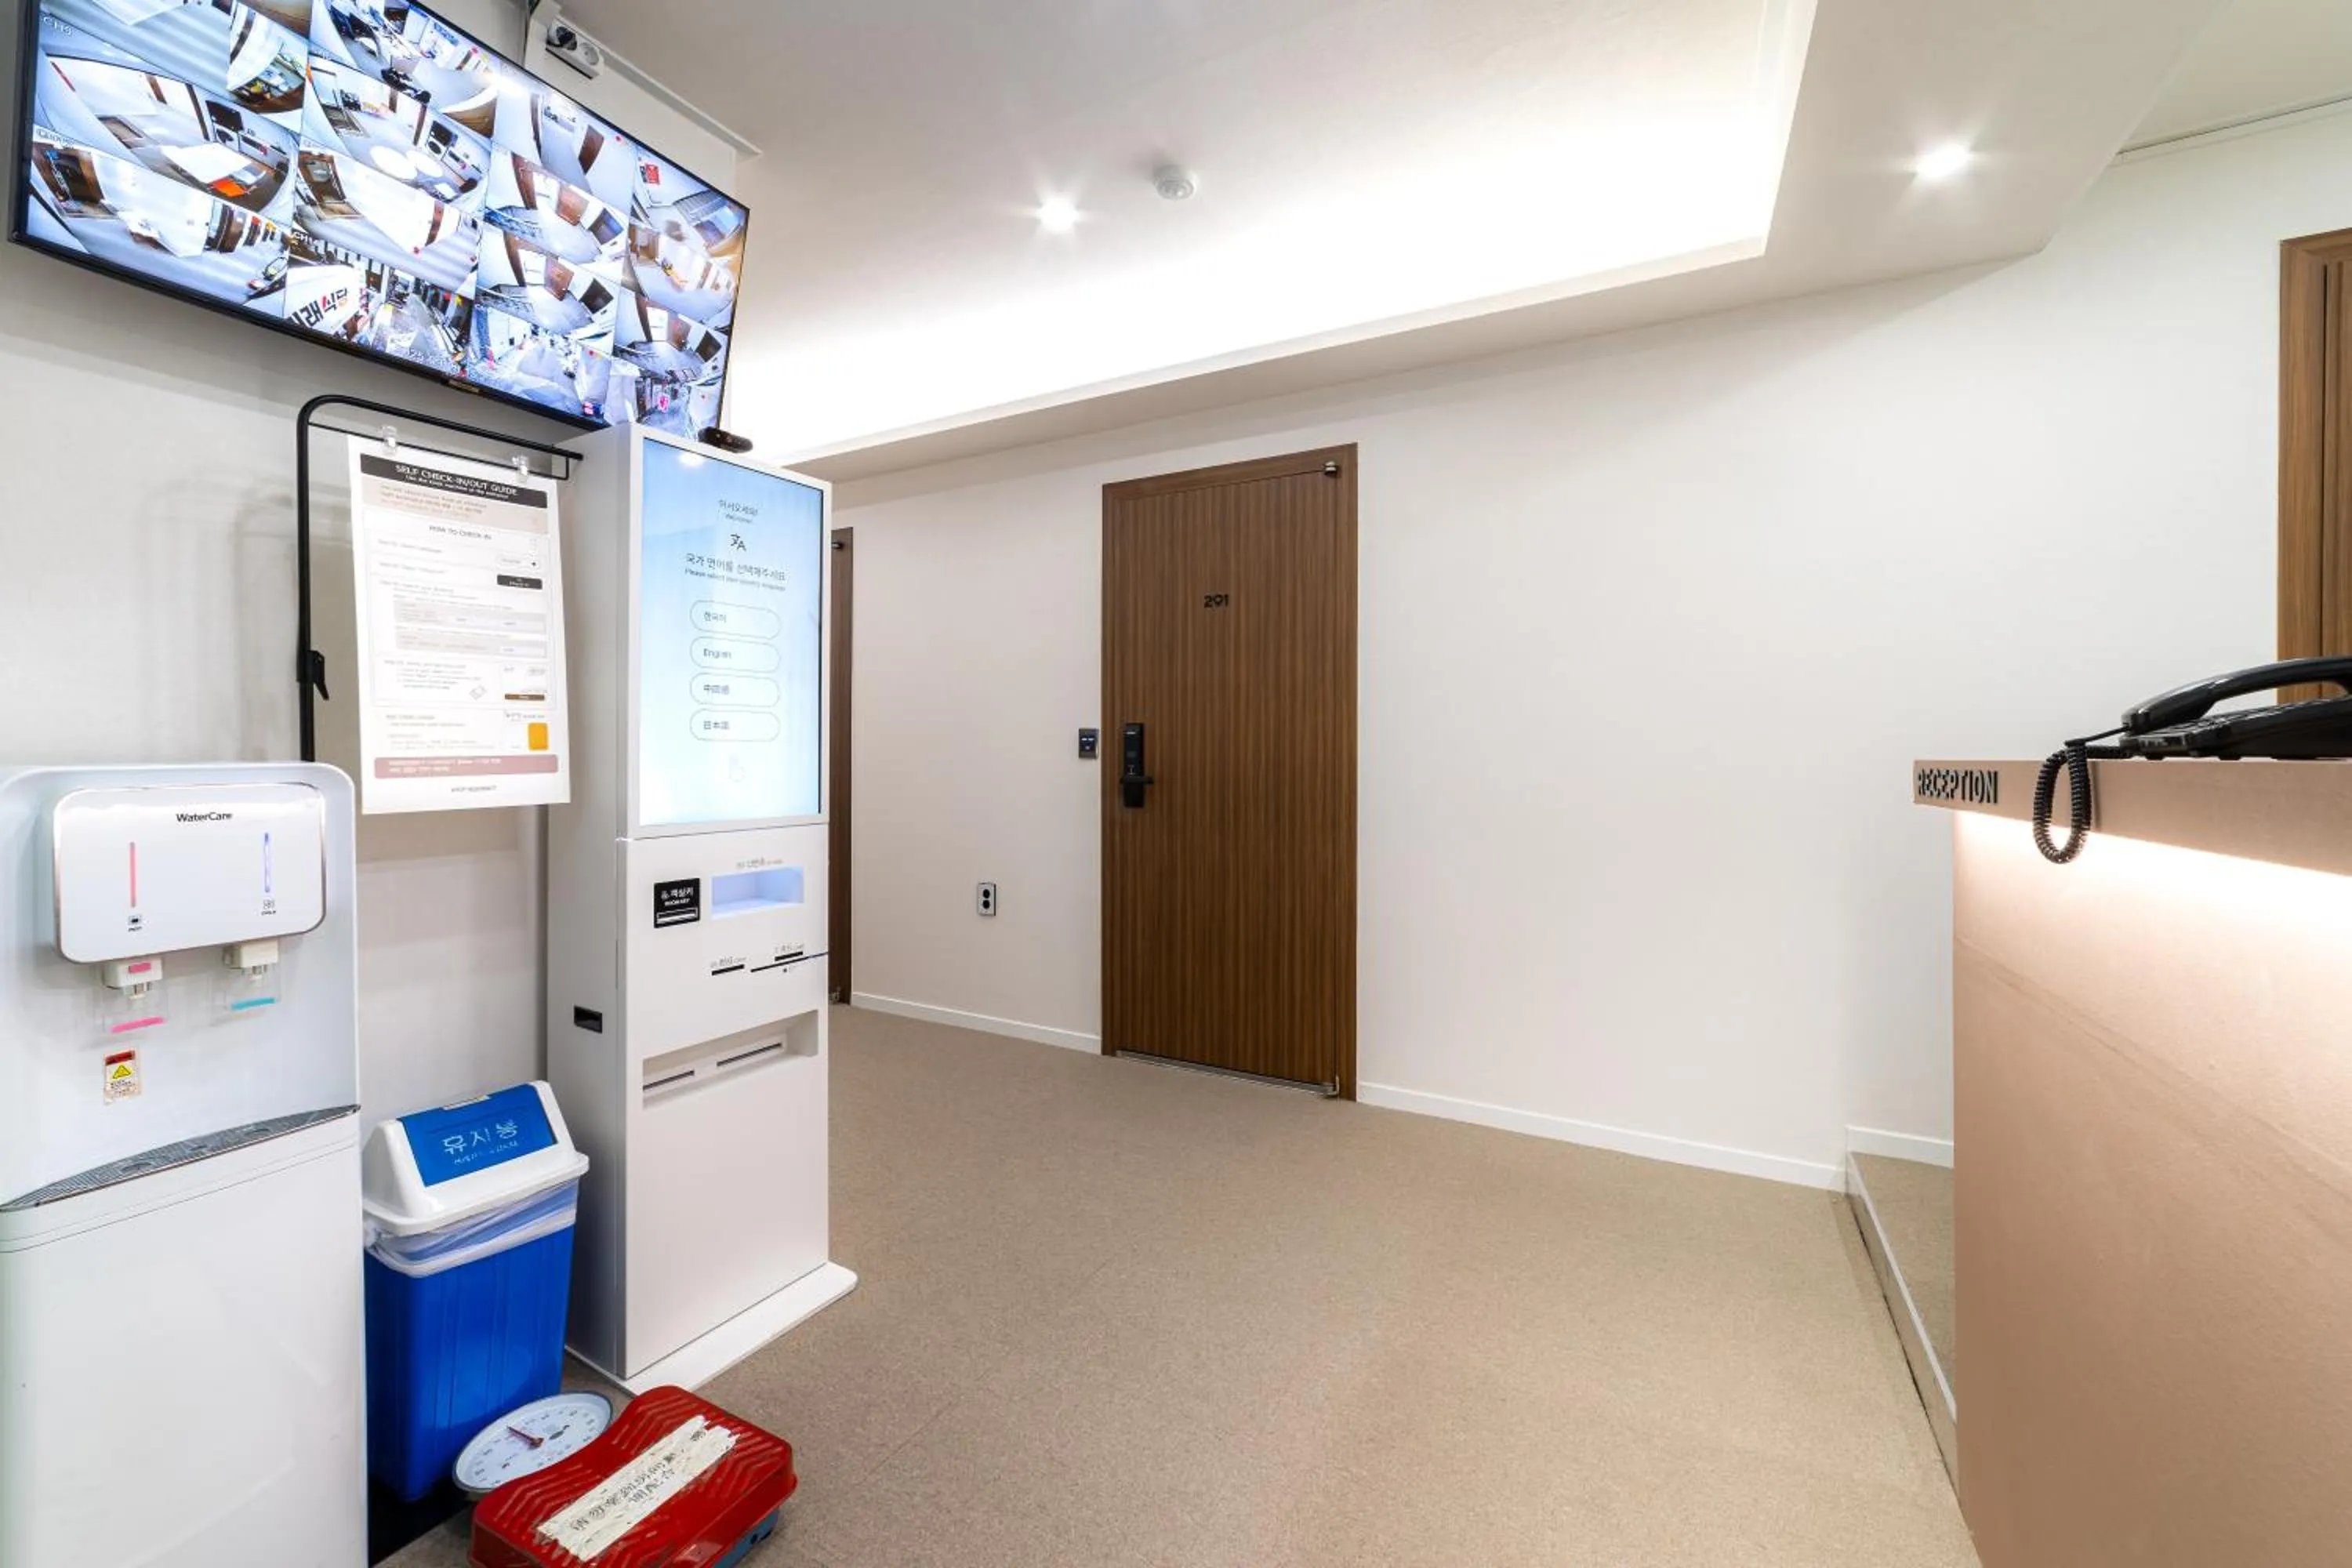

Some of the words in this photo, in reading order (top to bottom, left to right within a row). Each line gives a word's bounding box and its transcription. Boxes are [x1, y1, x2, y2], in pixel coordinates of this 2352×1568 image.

[394, 464, 418, 474] SELF
[491, 483, 519, 495] GUIDE
[1203, 593, 1229, 609] 201
[703, 648, 731, 659] English
[1918, 768, 1998, 804] RECEPTION
[176, 811, 233, 823] WaterCare
